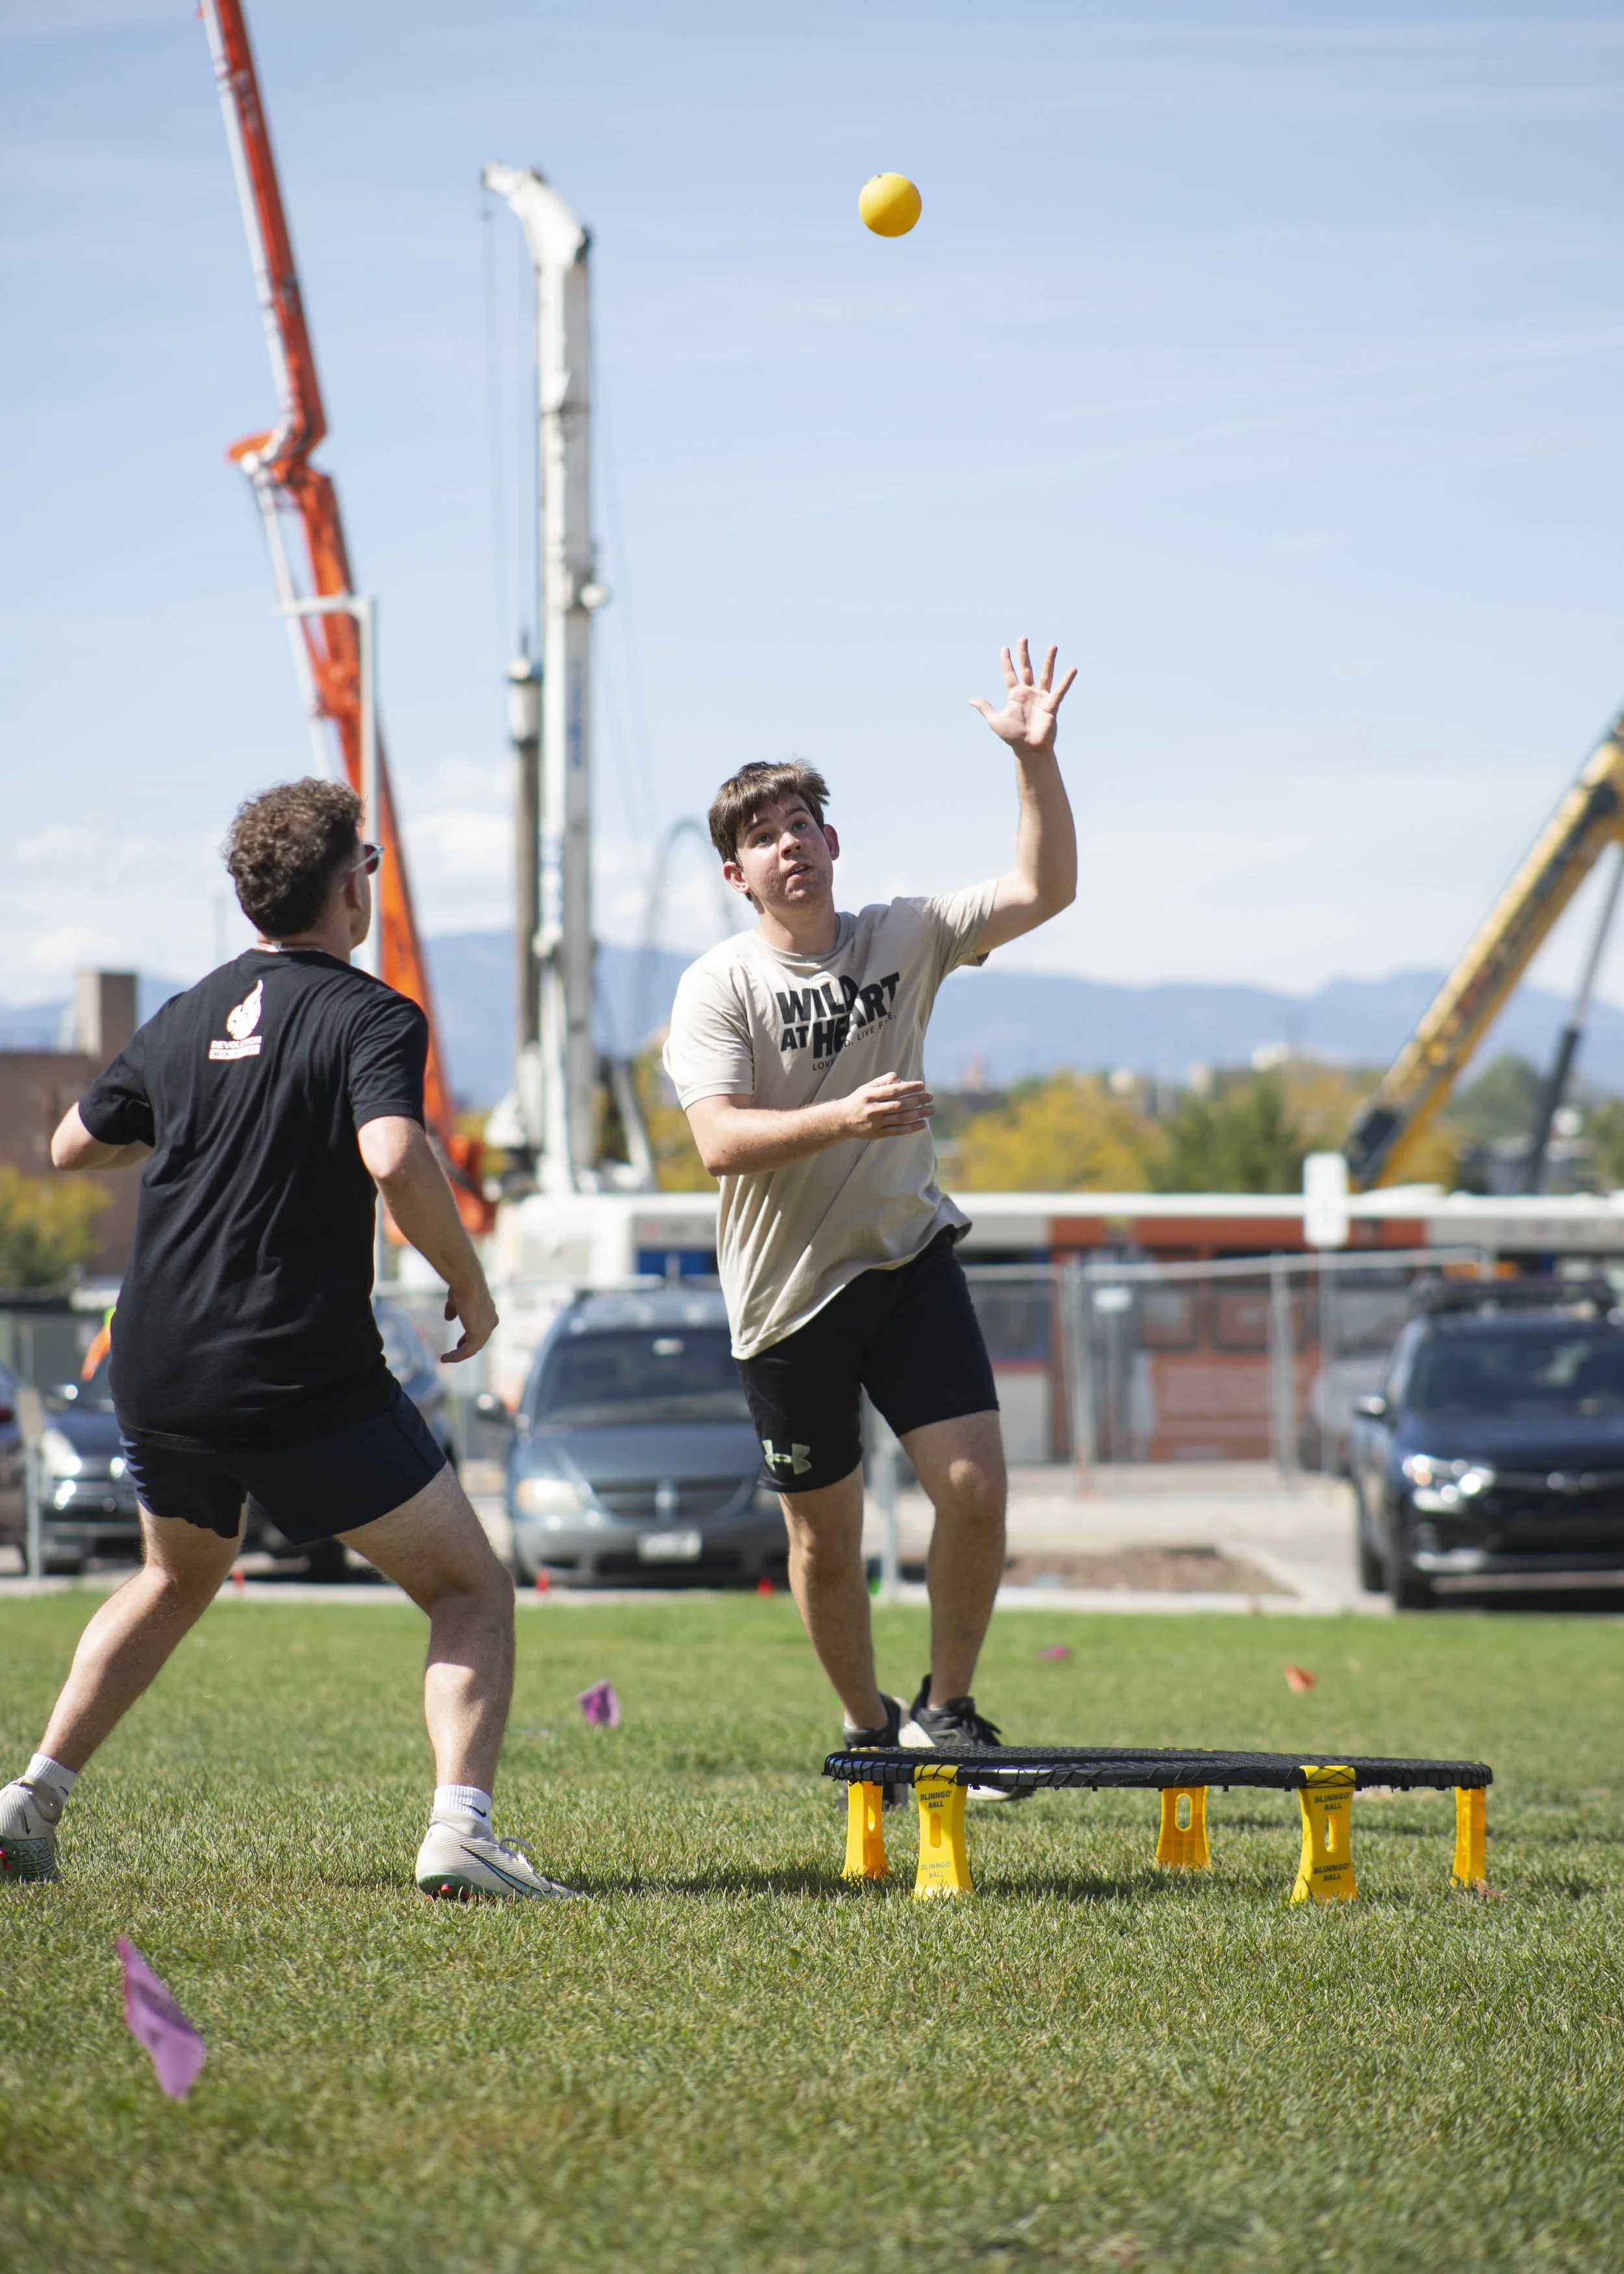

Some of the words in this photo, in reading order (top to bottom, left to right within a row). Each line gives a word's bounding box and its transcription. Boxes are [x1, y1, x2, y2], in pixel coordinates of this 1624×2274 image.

[776, 975, 859, 1025] WILD
[857, 1025, 874, 1041] LIVE
[878, 1011, 896, 1030] FE.
[780, 1025, 809, 1052] AT
[920, 1791, 951, 1801] BLINNGO
[1314, 1792, 1350, 1804] BLINNGO
[928, 1800, 944, 1809] BALL
[1324, 1802, 1342, 1811] BALL
[920, 1861, 951, 1871] BLINNGO
[1313, 1863, 1349, 1874] BLINNGO
[1323, 1872, 1341, 1882] BALL
